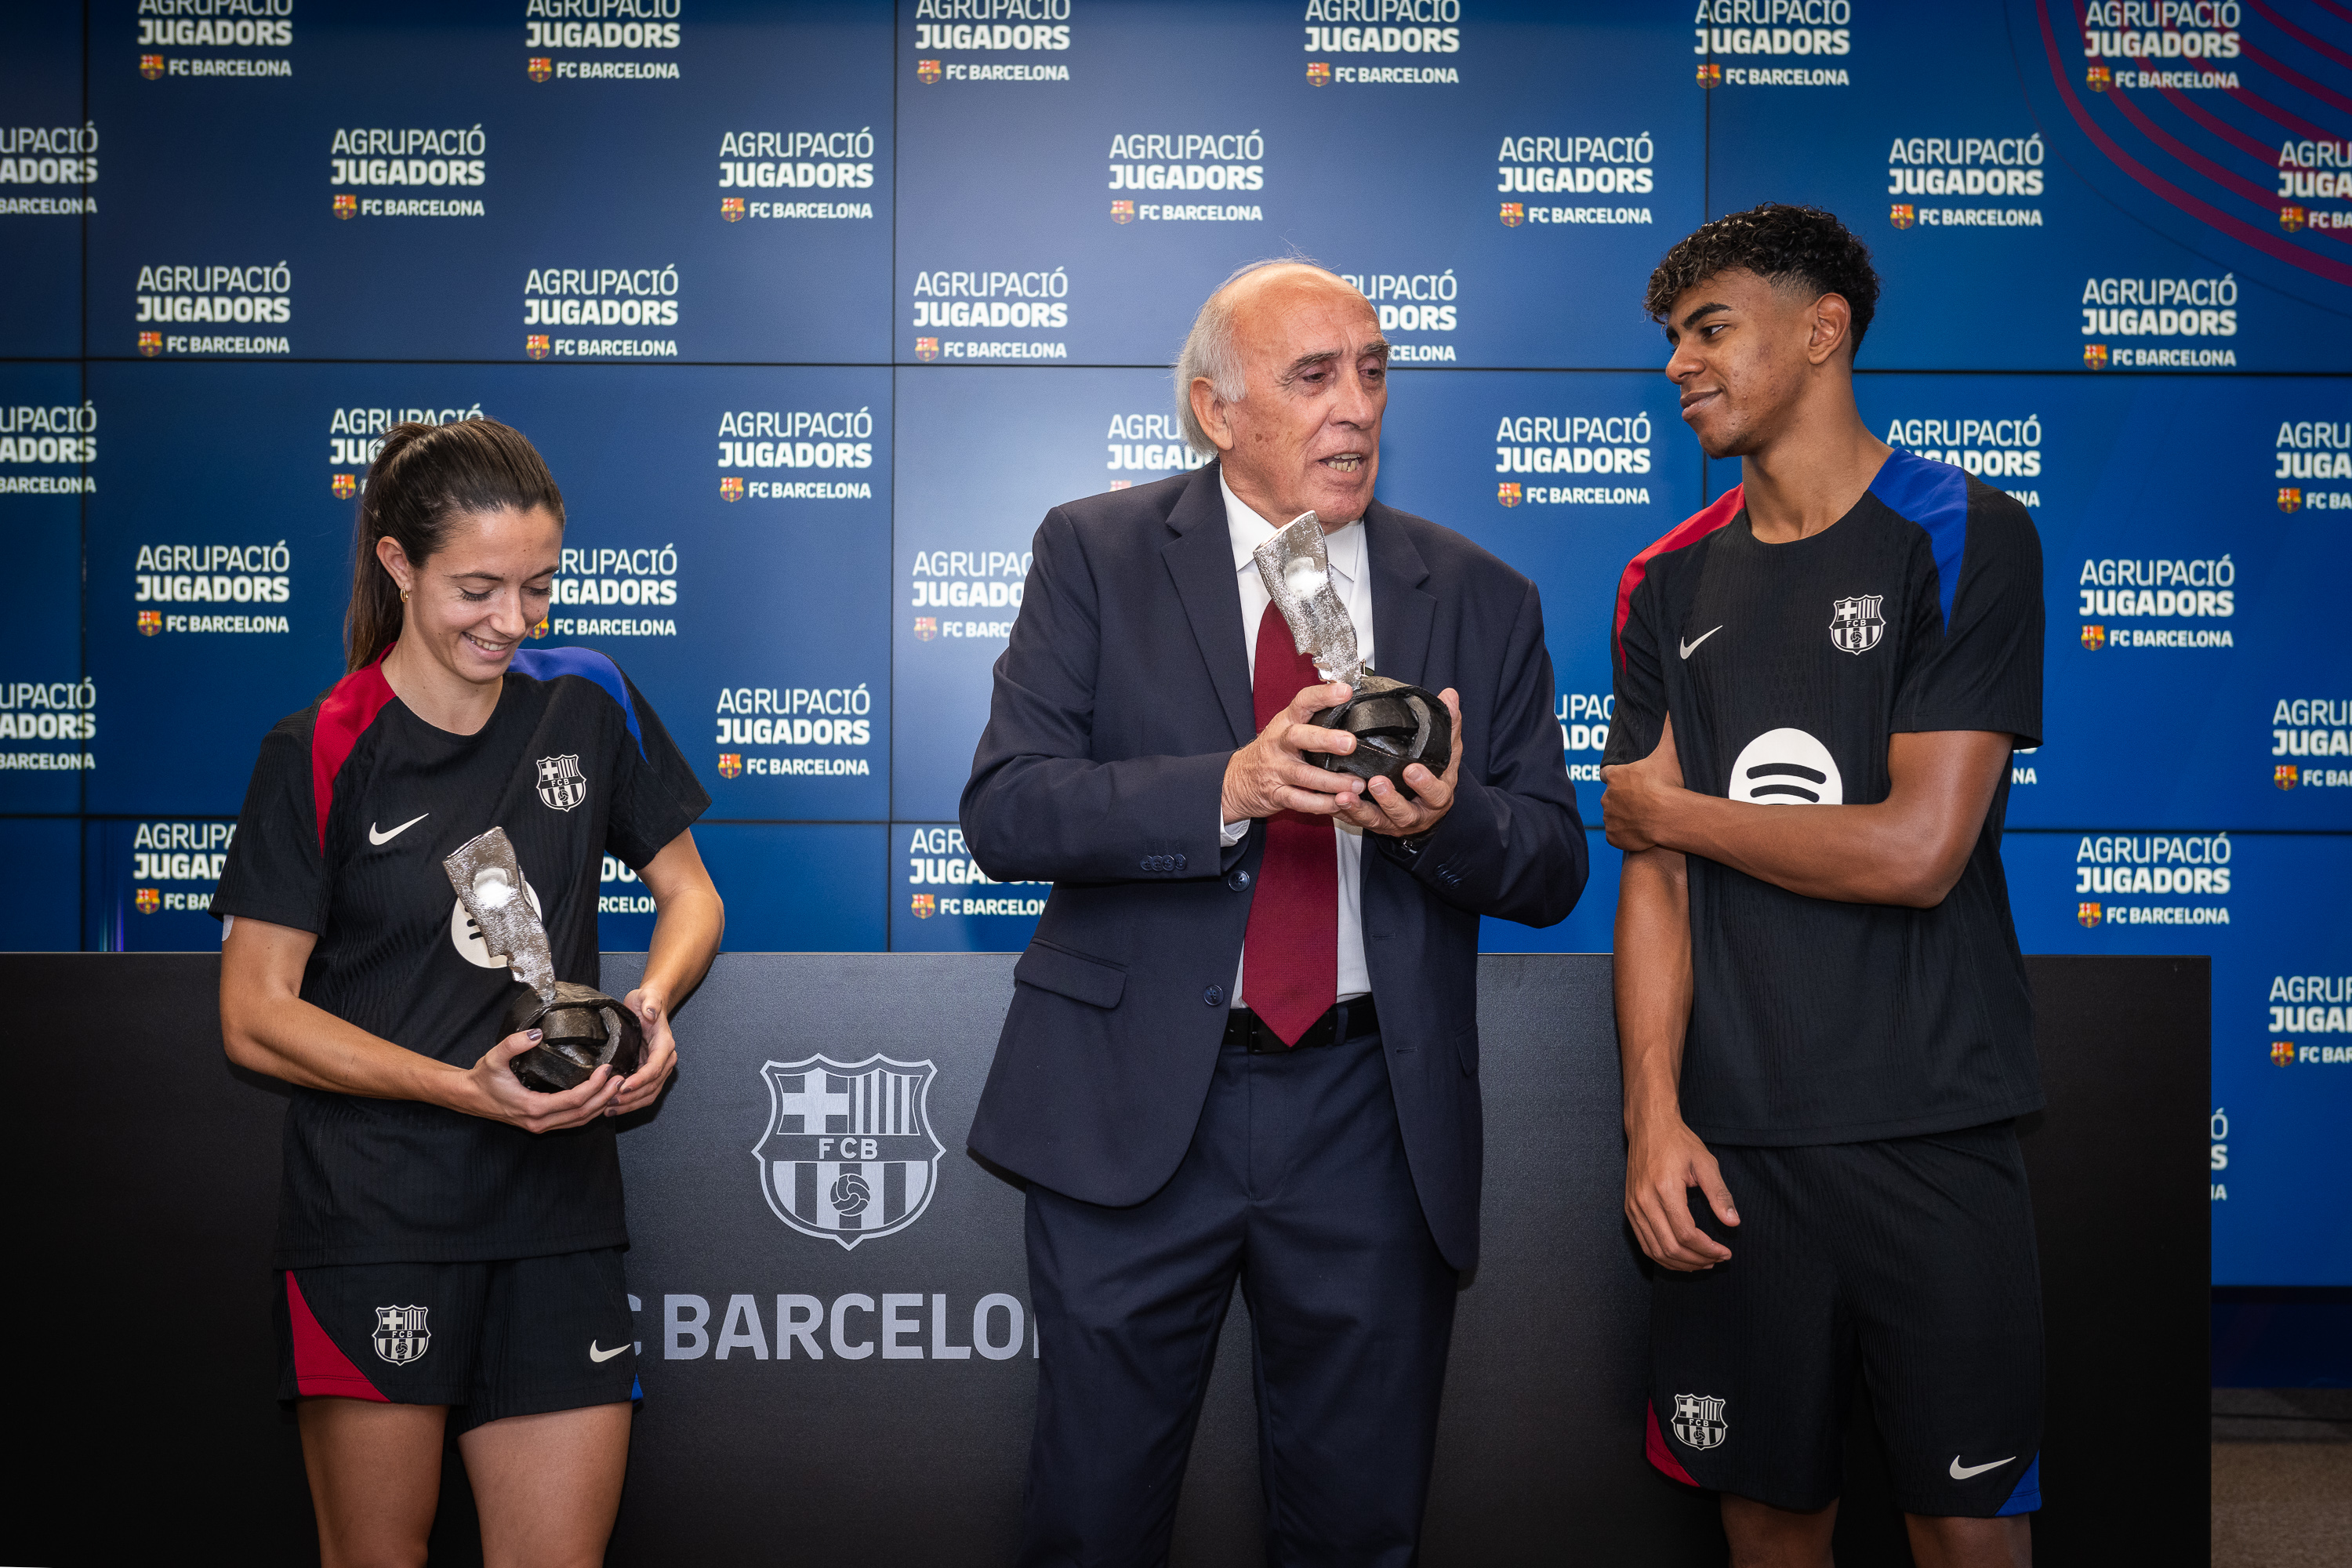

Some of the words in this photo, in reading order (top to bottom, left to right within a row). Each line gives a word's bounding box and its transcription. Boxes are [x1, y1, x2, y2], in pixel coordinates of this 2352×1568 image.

[138, 19, 292, 46] JUGADORS
[525, 22, 681, 49] JUGADORS
[915, 24, 1070, 51] JUGADORS
[1304, 27, 1460, 53] JUGADORS
[1693, 27, 1850, 55] JUGADORS
[2084, 31, 2240, 58] JUGADORS
[169, 59, 190, 76] FC
[191, 59, 292, 77] BARCELONA
[556, 62, 577, 78] FC
[579, 62, 681, 79] BARCELONA
[946, 64, 967, 81] FC
[968, 64, 1070, 81] BARCELONA
[1334, 67, 1356, 83] FC
[1358, 67, 1459, 84] BARCELONA
[1725, 67, 1747, 85] FC
[1748, 68, 1849, 86] BARCELONA
[2114, 71, 2136, 89] FC
[2137, 71, 2240, 89] BARCELONA
[331, 123, 486, 156] AGRUPACIÓ
[719, 126, 874, 158] AGRUPACIÓ
[1109, 129, 1264, 161] AGRUPACIÓ
[1497, 131, 1653, 164] AGRUPACIÓ
[1888, 132, 2045, 166] AGRUPACIÓ
[0, 157, 98, 184] ADORS
[331, 159, 485, 186] JUGADORS
[719, 162, 874, 189] JUGADORS
[1108, 164, 1264, 191] JUGADORS
[1497, 166, 1653, 194] JUGADORS
[1888, 168, 2044, 196] JUGADORS
[361, 198, 383, 216] FC
[384, 199, 485, 216] BARCELONA
[750, 201, 771, 219] FC
[772, 202, 873, 219] BARCELONA
[1139, 205, 1160, 220] FC
[1162, 205, 1263, 221] BARCELONA
[1528, 207, 1549, 223] FC
[1551, 207, 1653, 224] BARCELONA
[1918, 208, 1940, 226] FC
[1941, 209, 2043, 227] BARCELONA
[2308, 211, 2330, 229] FC
[136, 260, 291, 293] AGRUPACIÓ
[524, 263, 679, 296] AGRUPACIÓ
[913, 266, 1069, 298] AGRUPACIÓ
[2082, 273, 2238, 307] AGRUPACIÓ
[136, 296, 291, 323] JUGADORS
[524, 299, 678, 326] JUGADORS
[913, 301, 1068, 328] JUGADORS
[1371, 304, 1457, 332] DORS
[2081, 308, 2238, 336] JUGADORS
[166, 336, 188, 353] FC
[190, 336, 290, 354] BARCELONA
[554, 339, 575, 356] FC
[577, 339, 678, 357] BARCELONA
[943, 341, 964, 358] FC
[967, 342, 1068, 358] BARCELONA
[2112, 348, 2133, 366] FC
[2135, 348, 2237, 367] BARCELONA
[718, 405, 873, 439] AGRUPACIÓ
[1496, 411, 1651, 444] AGRUPACIÓ
[1886, 413, 2042, 448] AGRUPACIÓ
[0, 436, 97, 463] ADORS
[717, 441, 873, 469] JUGADORS
[1106, 444, 1212, 471] JUGAD
[1495, 446, 1651, 474] JUGADORS
[748, 481, 769, 499] FC
[771, 482, 872, 499] BARCELONA
[1526, 487, 1548, 504] FC
[1549, 487, 1650, 505] BARCELONA
[2306, 492, 2327, 510] FC
[136, 539, 290, 573] AGRUPACIÓ
[555, 543, 677, 576] RUPACIÓ
[2079, 554, 2235, 587] AGRUPACIÓ
[135, 575, 290, 603] JUGADORS
[2078, 589, 2234, 617] JUGADORS
[166, 615, 187, 633] FC
[189, 615, 290, 633] BARCELONA
[554, 618, 575, 636] FC
[576, 619, 677, 636] BARCELONA
[942, 621, 964, 638] FC
[965, 621, 1014, 639] BARC
[2109, 630, 2130, 647] FC
[2132, 630, 2234, 648] BARCELONA
[717, 682, 871, 716] AGRUPACIÓ
[0, 713, 96, 740] ADORS
[2272, 699, 2352, 727] AGRU
[716, 718, 870, 746] JUGADORS
[2271, 729, 2352, 756] JUGA
[746, 758, 768, 775] FC
[769, 758, 870, 775] BARCELONA
[2302, 769, 2323, 787] FC
[2076, 832, 2231, 864] AGRUPACIÓ
[2075, 866, 2230, 895] JUGADORS
[164, 893, 185, 910] FC
[940, 898, 960, 915] FC
[2106, 906, 2127, 924] FC
[2129, 907, 2230, 924] BARCELONA
[2299, 1046, 2320, 1063] FC
[818, 1138, 878, 1160] FCB
[664, 1293, 1040, 1360] BARCELO
